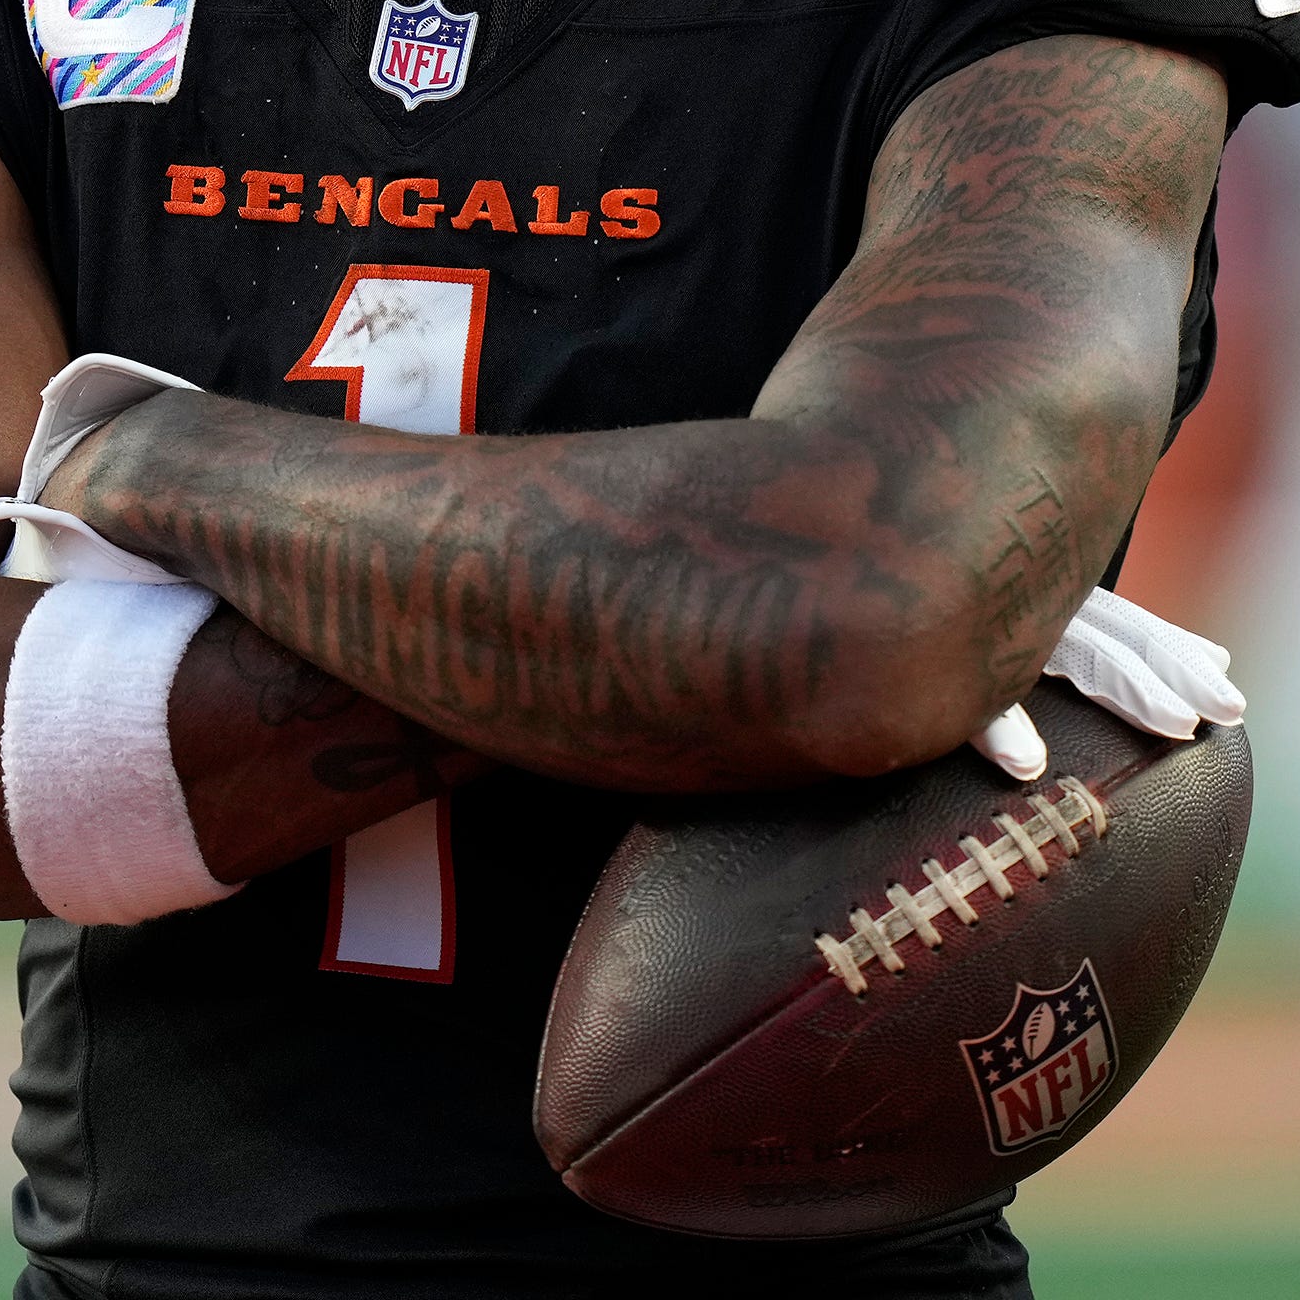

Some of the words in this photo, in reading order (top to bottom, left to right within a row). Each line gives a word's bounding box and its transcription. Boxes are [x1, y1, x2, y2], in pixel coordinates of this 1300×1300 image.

[386, 40, 452, 88] NFL
[163, 164, 661, 240] BENGALS
[997, 1037, 1107, 1143] NFL
